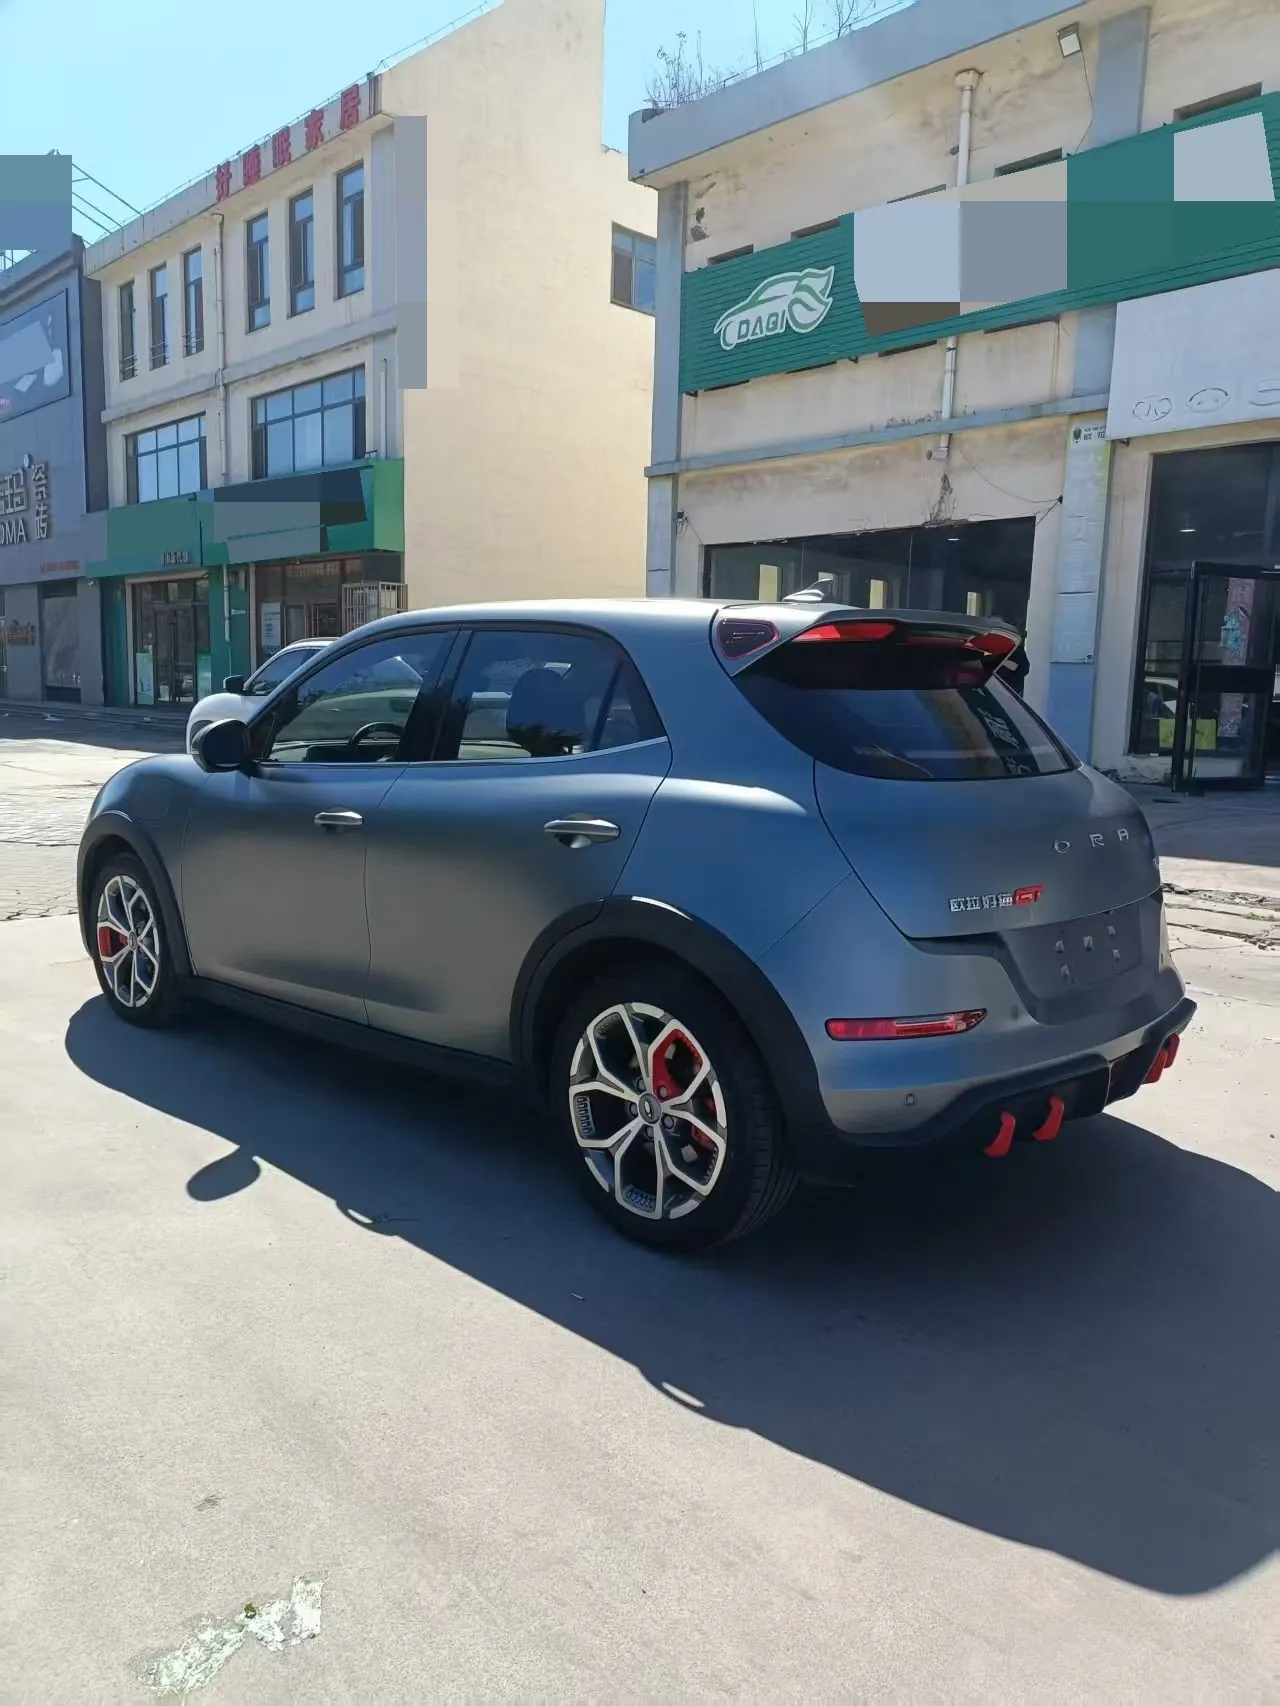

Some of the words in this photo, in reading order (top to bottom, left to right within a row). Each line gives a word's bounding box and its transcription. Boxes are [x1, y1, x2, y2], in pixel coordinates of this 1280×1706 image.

[215, 84, 361, 202] 好睡眠家居
[737, 309, 786, 340] DAQI
[32, 463, 48, 539] 瓷砖
[1054, 828, 1129, 853] ORA
